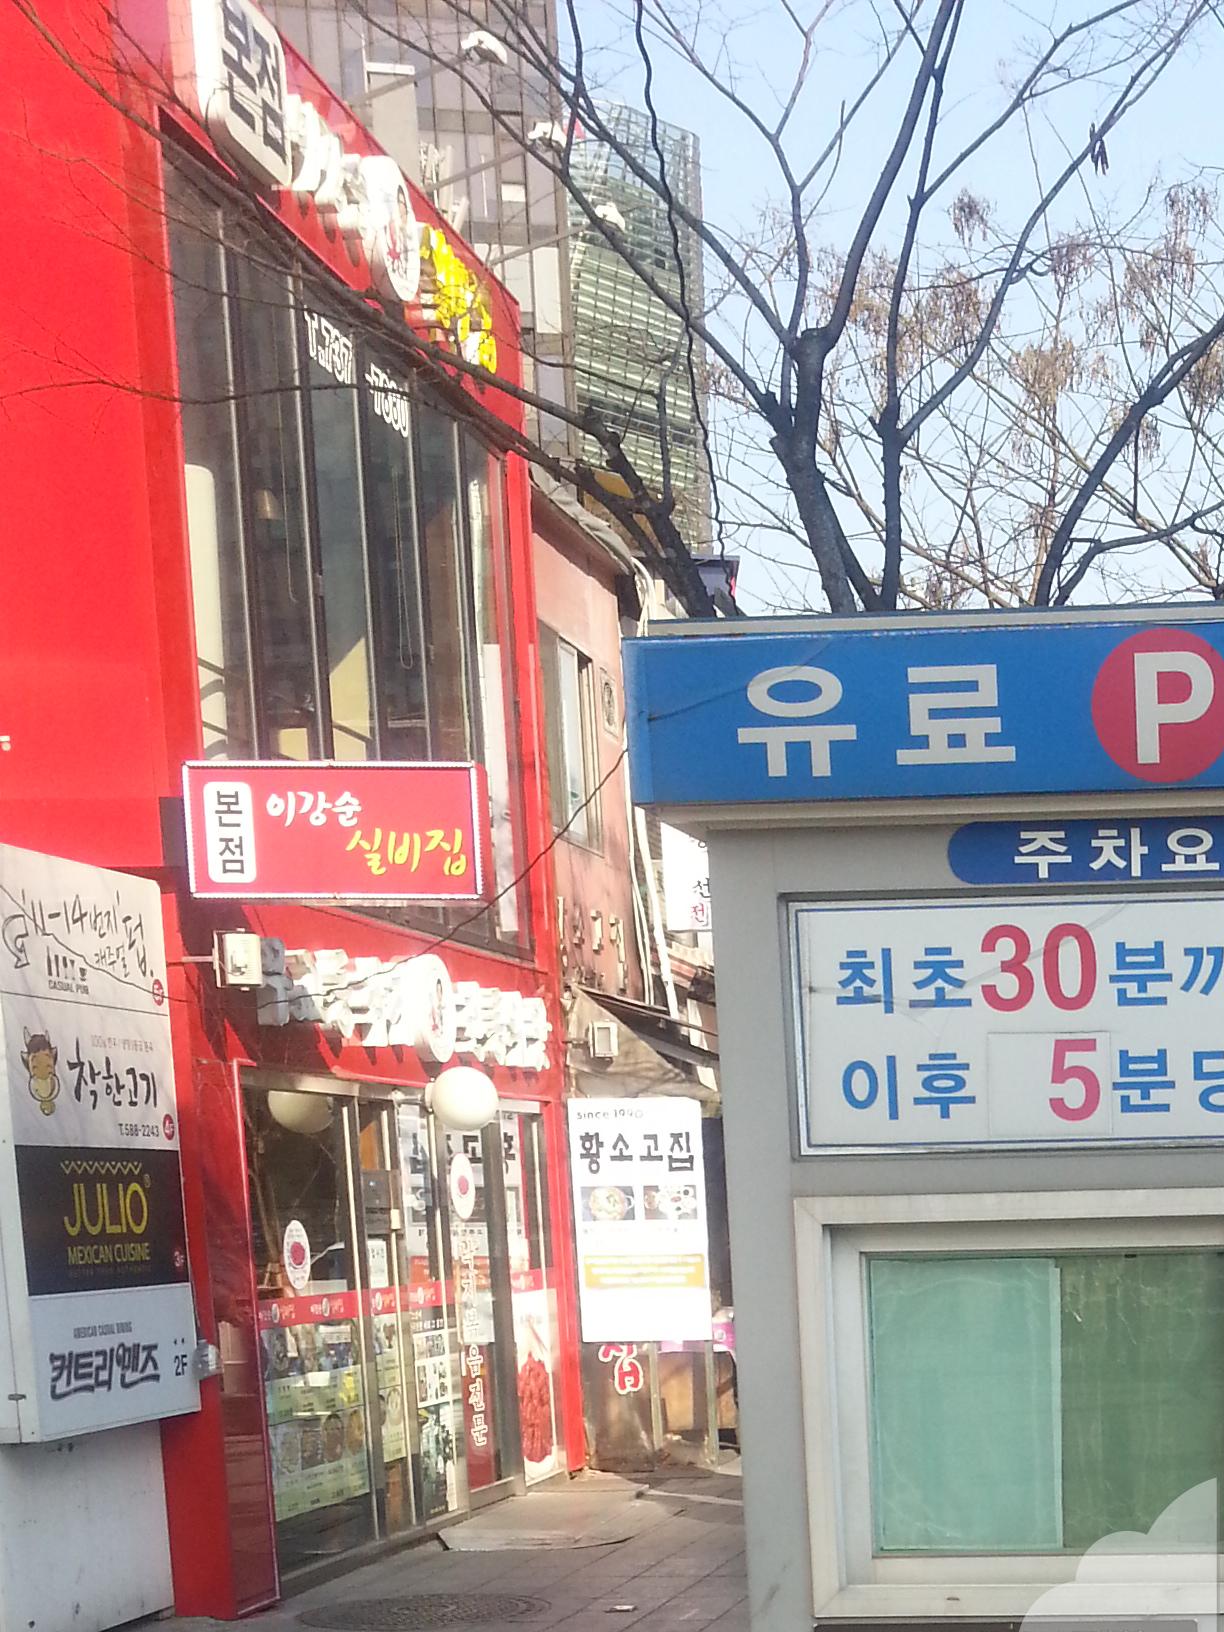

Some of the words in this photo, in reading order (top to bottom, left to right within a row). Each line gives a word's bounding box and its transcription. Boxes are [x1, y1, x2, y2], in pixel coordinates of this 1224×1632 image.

[737, 664, 1017, 777] 유료
[1135, 650, 1216, 765] P
[215, 790, 245, 875] 본점
[266, 790, 362, 827] 이강순
[345, 828, 466, 876] 실비집
[66, 1036, 157, 1110] 착한고기
[841, 1049, 976, 1122] 이후
[580, 1132, 694, 1174] 황소고집
[63, 1182, 148, 1236] JULIO
[68, 1245, 113, 1265] MEXICAN
[115, 1242, 151, 1262] CUISINE
[174, 1354, 188, 1376] 2F
